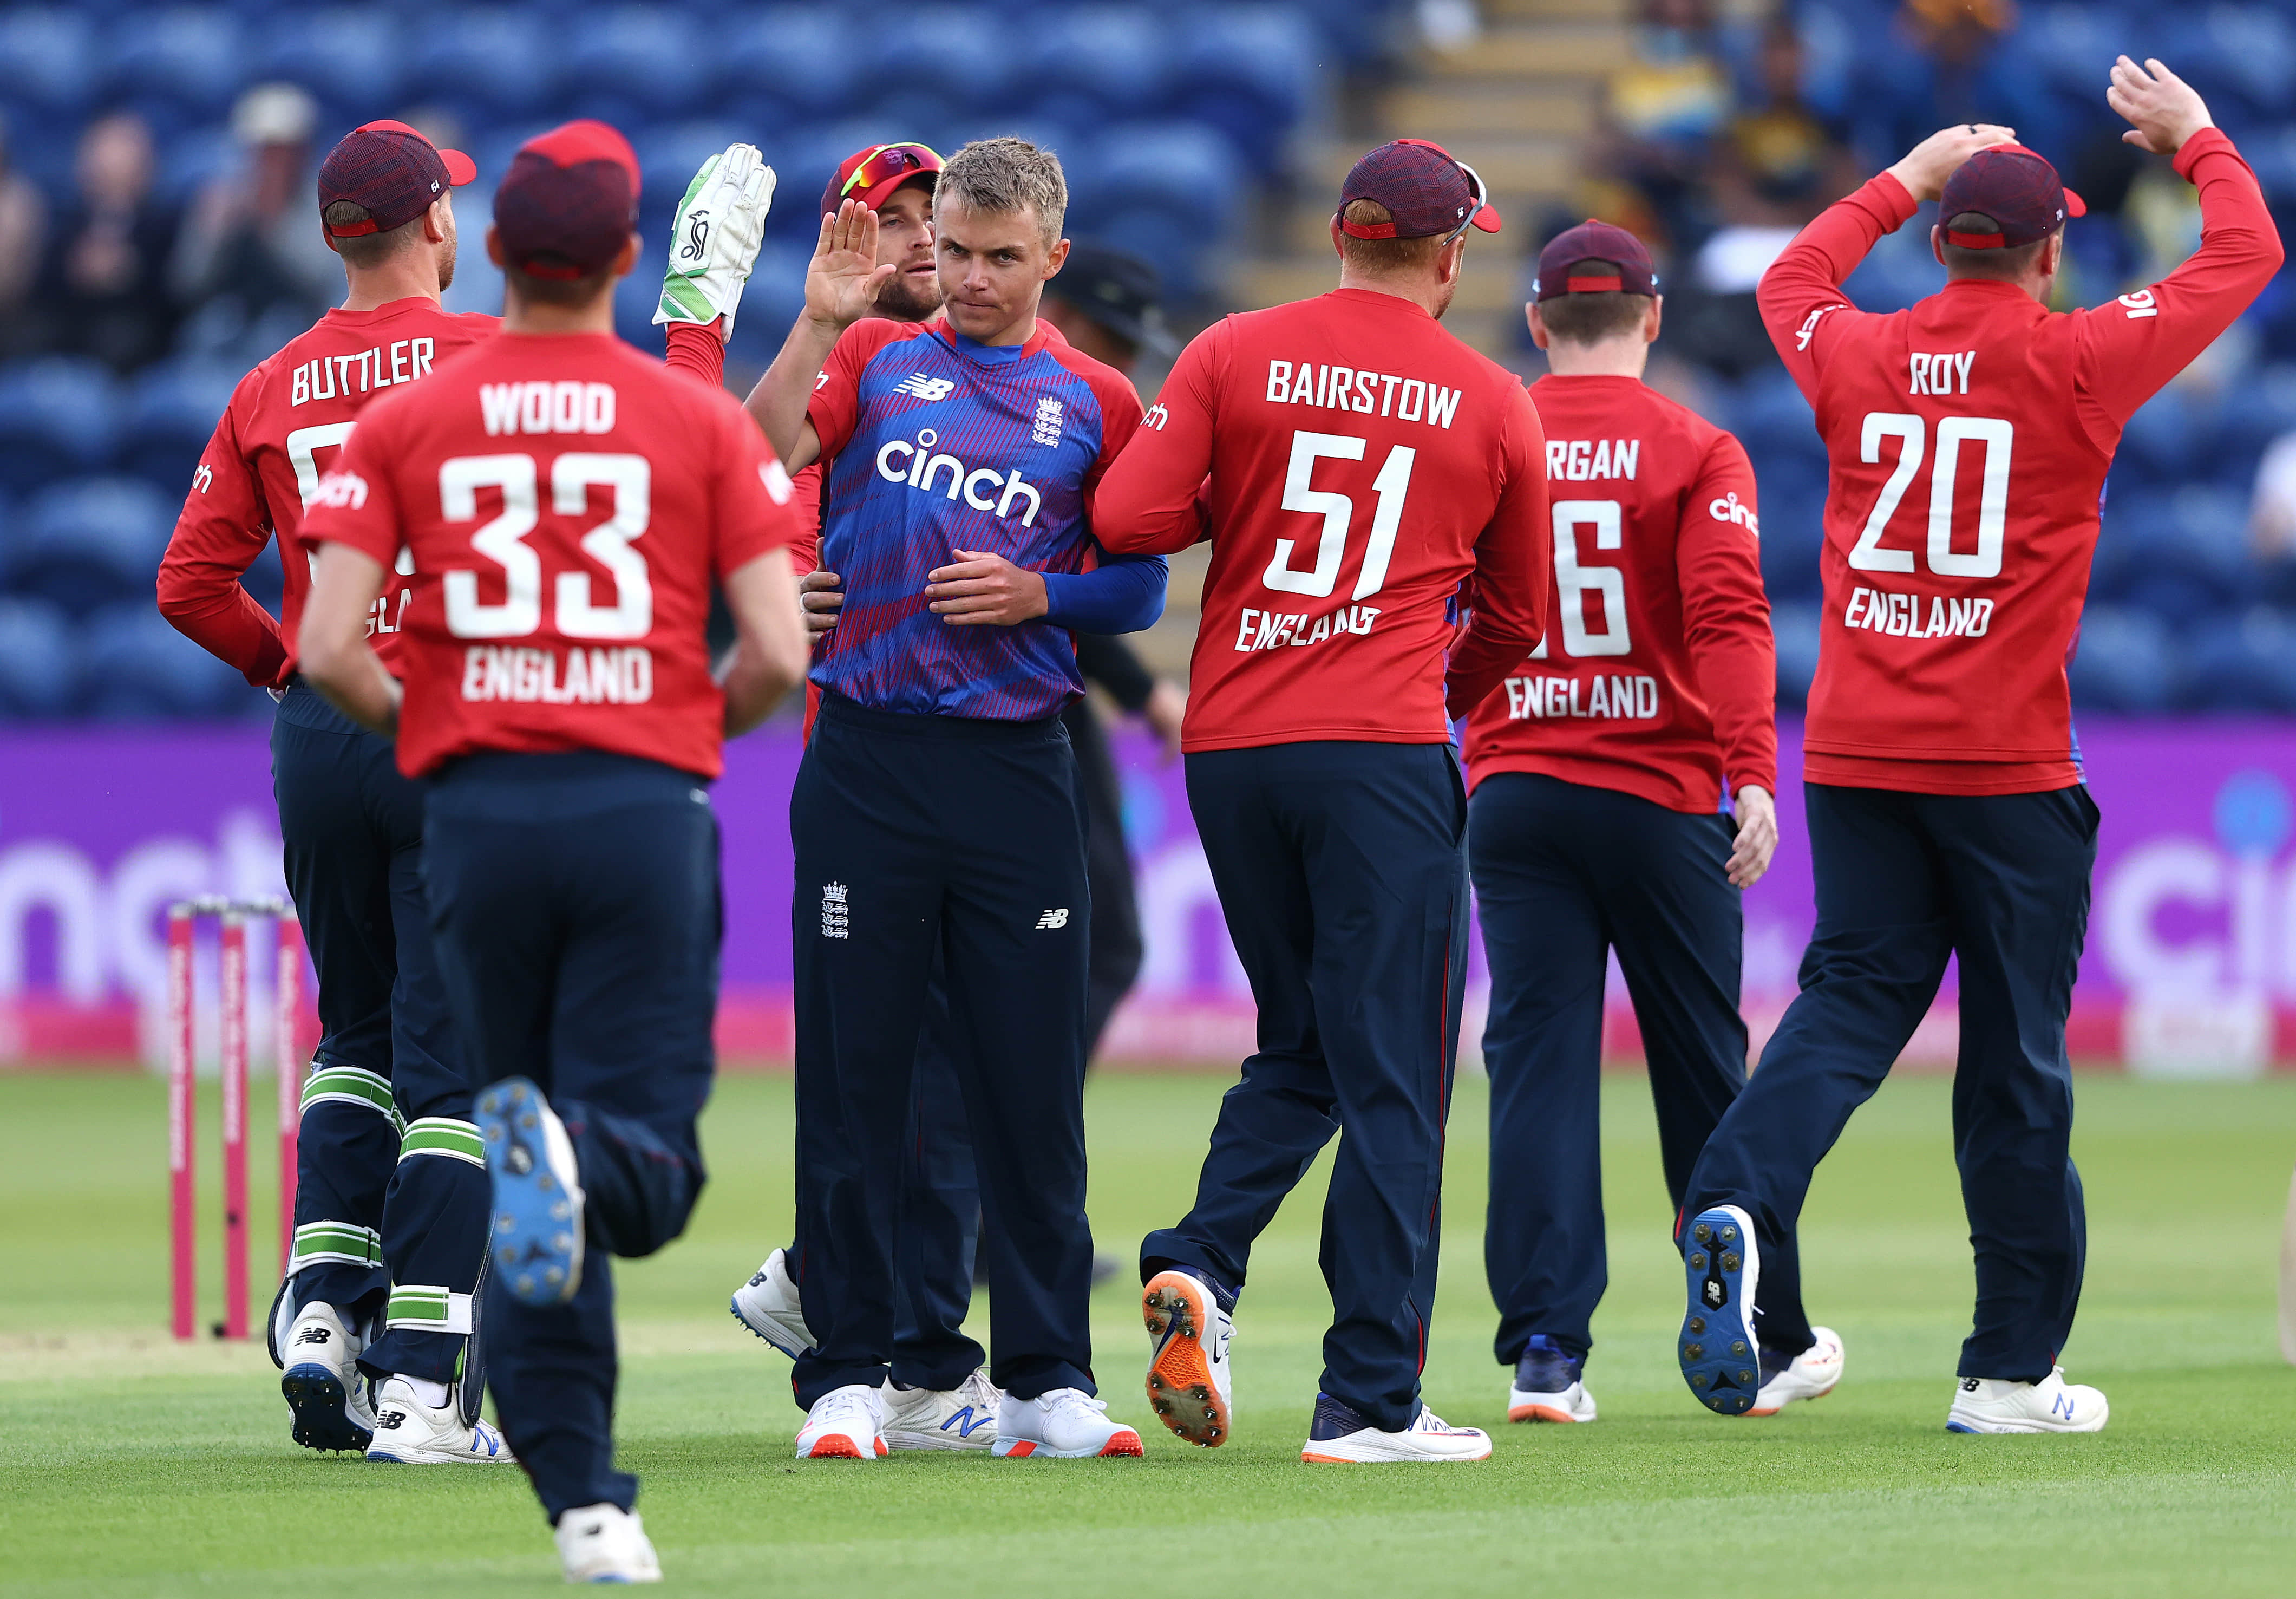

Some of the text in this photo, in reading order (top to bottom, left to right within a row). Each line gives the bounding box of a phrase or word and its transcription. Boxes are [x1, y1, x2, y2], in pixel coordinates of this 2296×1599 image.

[291, 337, 435, 407] BUTTLER
[1265, 360, 1463, 429] BAIRSTOW
[1909, 350, 1976, 396] ROY
[480, 380, 617, 435] WOOD
[876, 428, 1041, 528] cinch
[1546, 439, 1640, 481] RGAN
[1261, 430, 1417, 601] 51
[1709, 491, 1759, 539] cinc
[1847, 412, 2014, 578] 20
[438, 452, 653, 639] 33
[1527, 500, 1632, 658] 6
[1234, 605, 1383, 653] ENGLAND
[1843, 586, 1994, 639] ENGLAND
[460, 645, 653, 704] ENGLAND
[1503, 674, 1659, 720] ENGLAND
